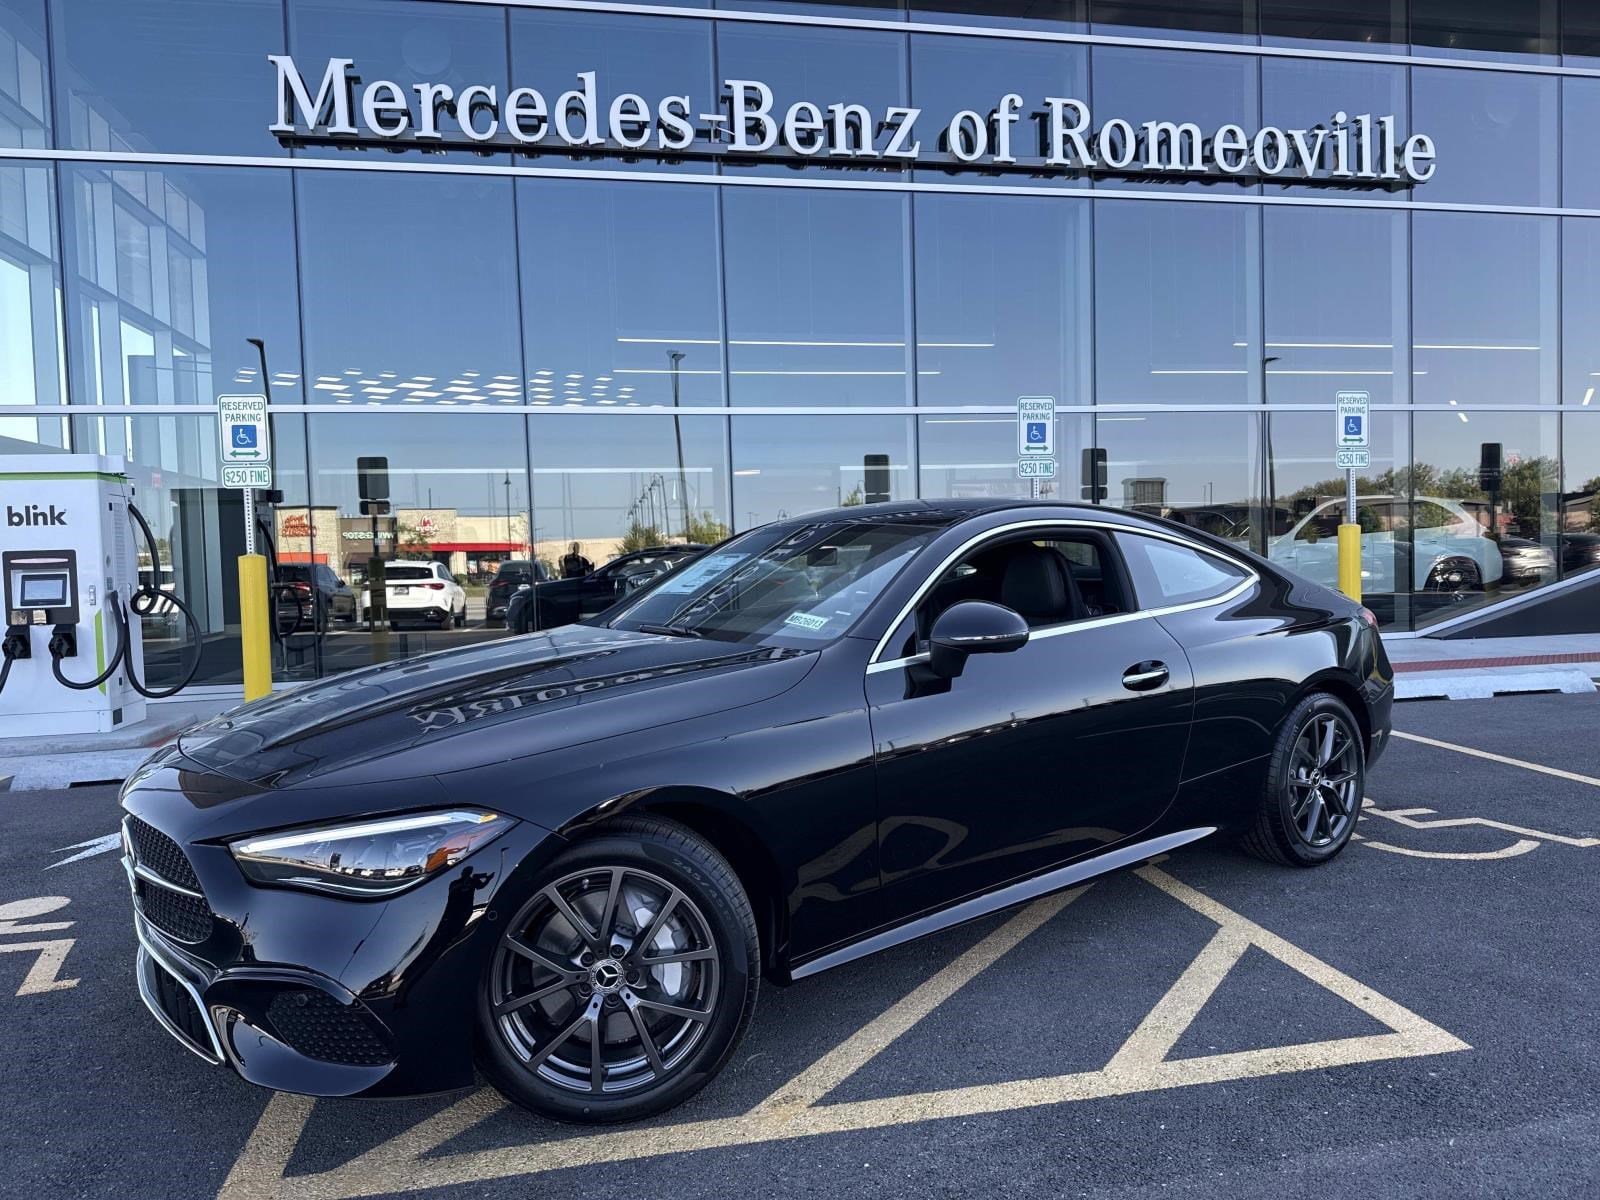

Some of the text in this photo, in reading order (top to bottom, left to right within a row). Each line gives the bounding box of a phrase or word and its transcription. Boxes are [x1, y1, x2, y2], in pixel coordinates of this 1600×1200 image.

[267, 54, 1437, 182] Mercedes-Benz of Romeoville
[1338, 396, 1368, 405] RESERVED
[221, 401, 264, 411] RESERVED
[1020, 402, 1053, 411] RESERVED
[1340, 406, 1366, 414] PARKING
[224, 413, 262, 422] PARKING
[1022, 412, 1051, 421] PARKING
[1338, 453, 1368, 464] $250 FINE
[1020, 462, 1053, 474] $250 FINE
[225, 470, 268, 483] $250 FINE
[7, 505, 67, 527] blink
